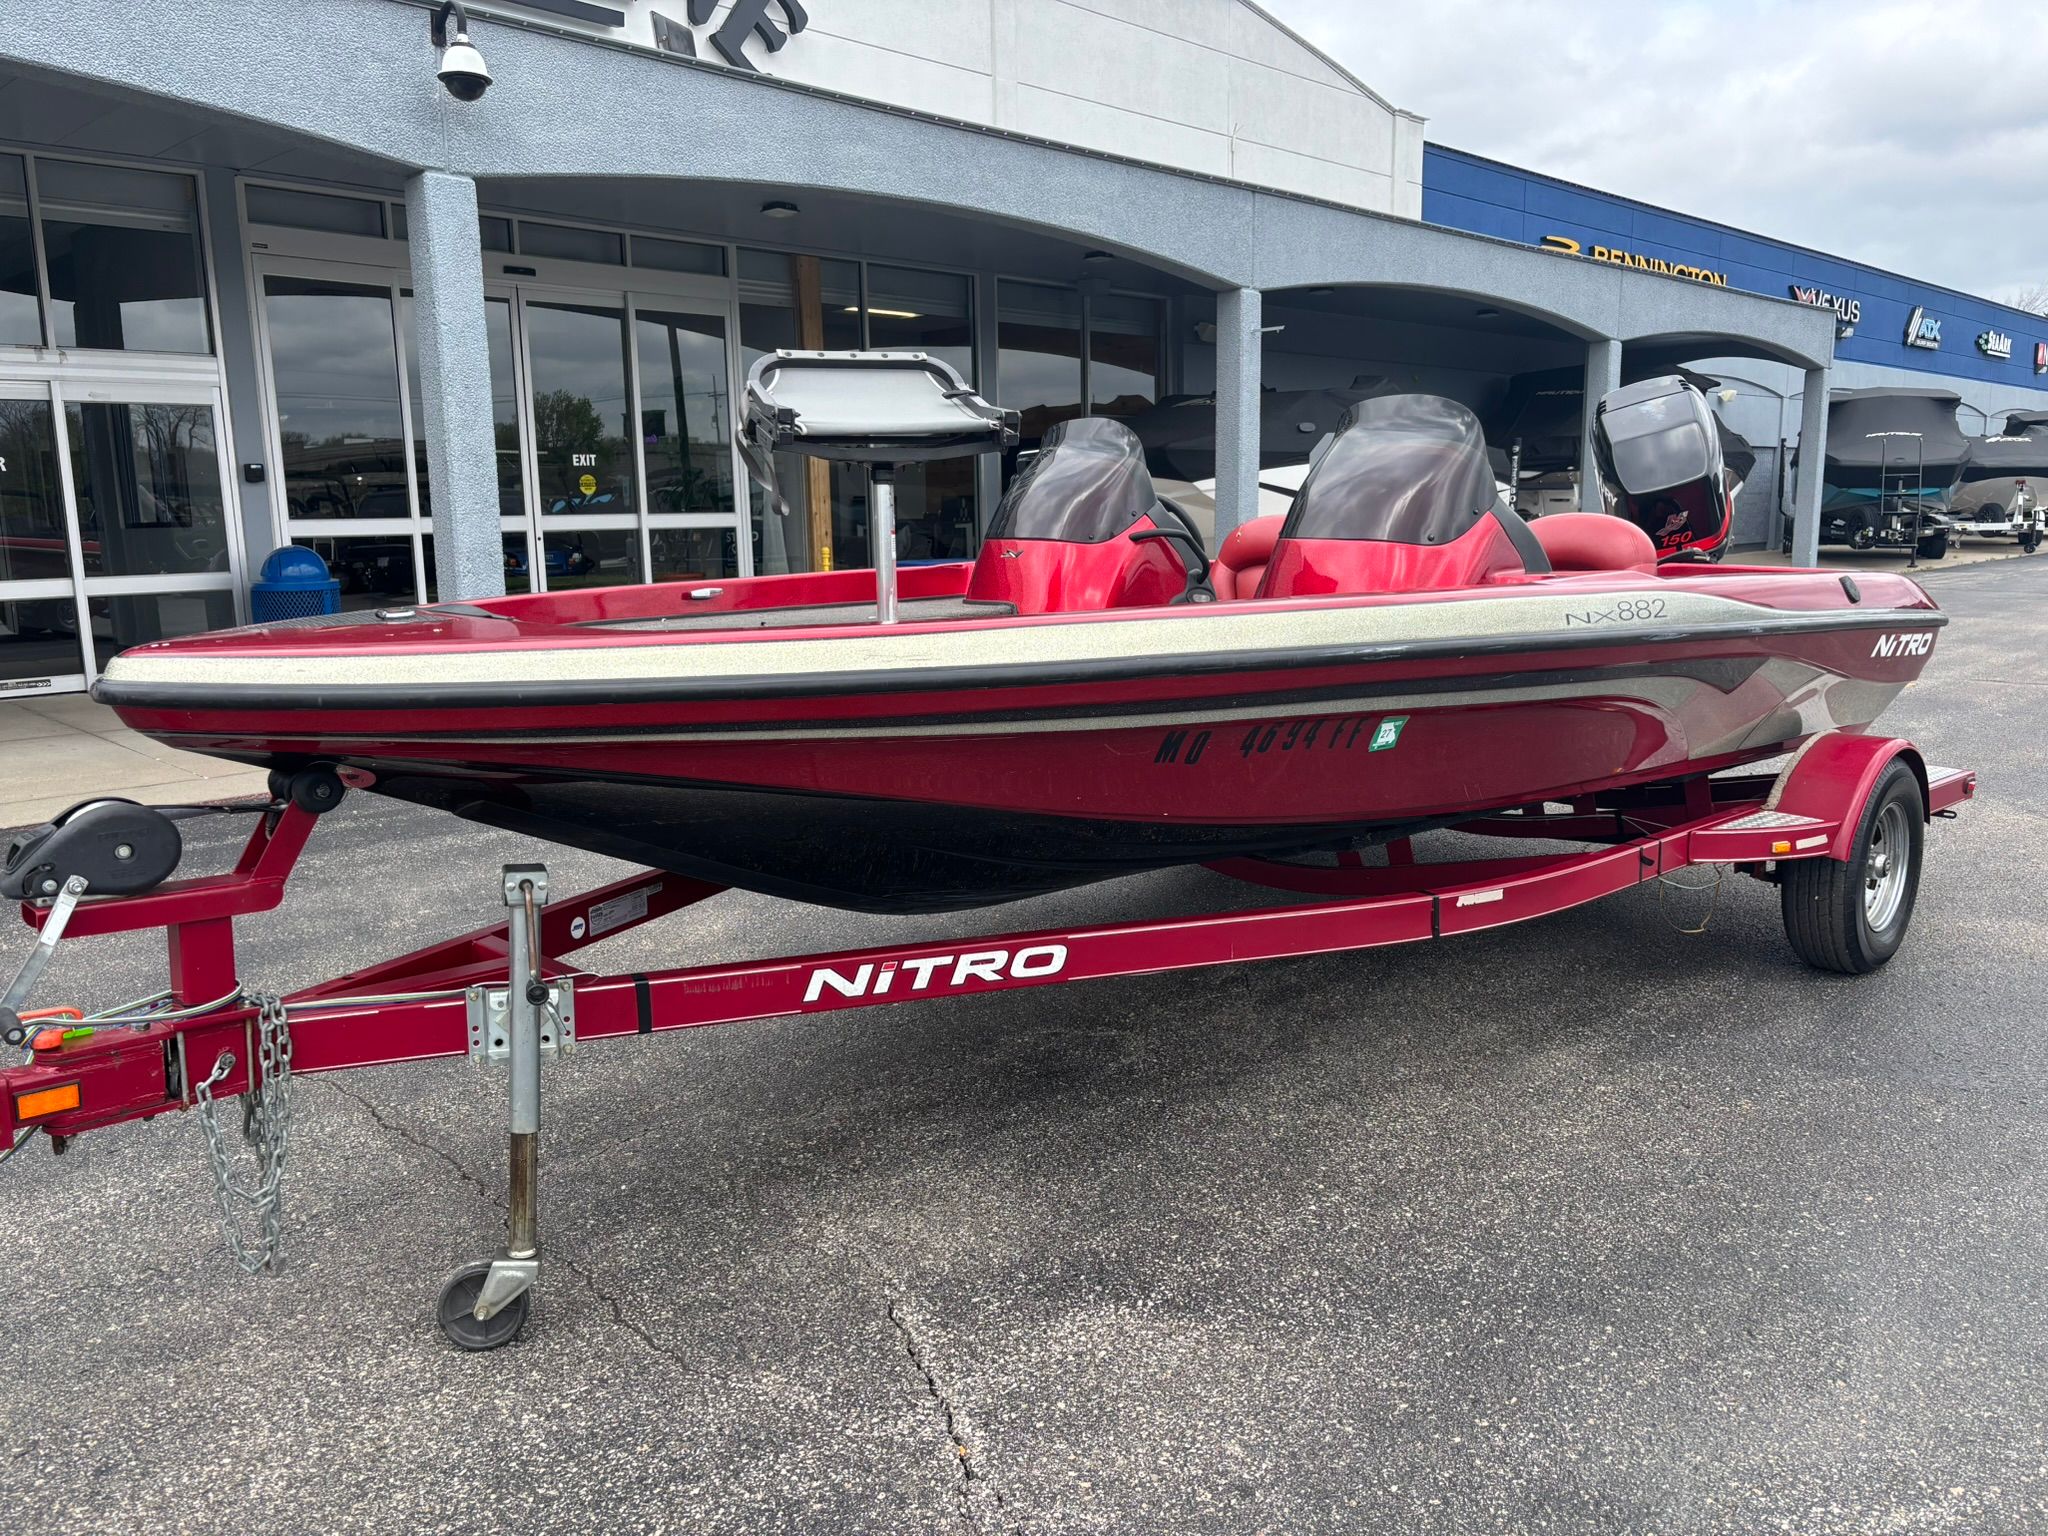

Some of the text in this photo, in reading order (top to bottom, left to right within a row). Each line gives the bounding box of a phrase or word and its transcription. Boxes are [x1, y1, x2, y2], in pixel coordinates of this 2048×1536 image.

[1918, 317, 1942, 341] ATX
[572, 454, 597, 467] EXIT
[1661, 531, 1693, 547] 150
[1565, 598, 1668, 626] NX882
[1153, 730, 1213, 765] MO
[1328, 717, 1369, 750] FF
[1380, 728, 1393, 739] 27
